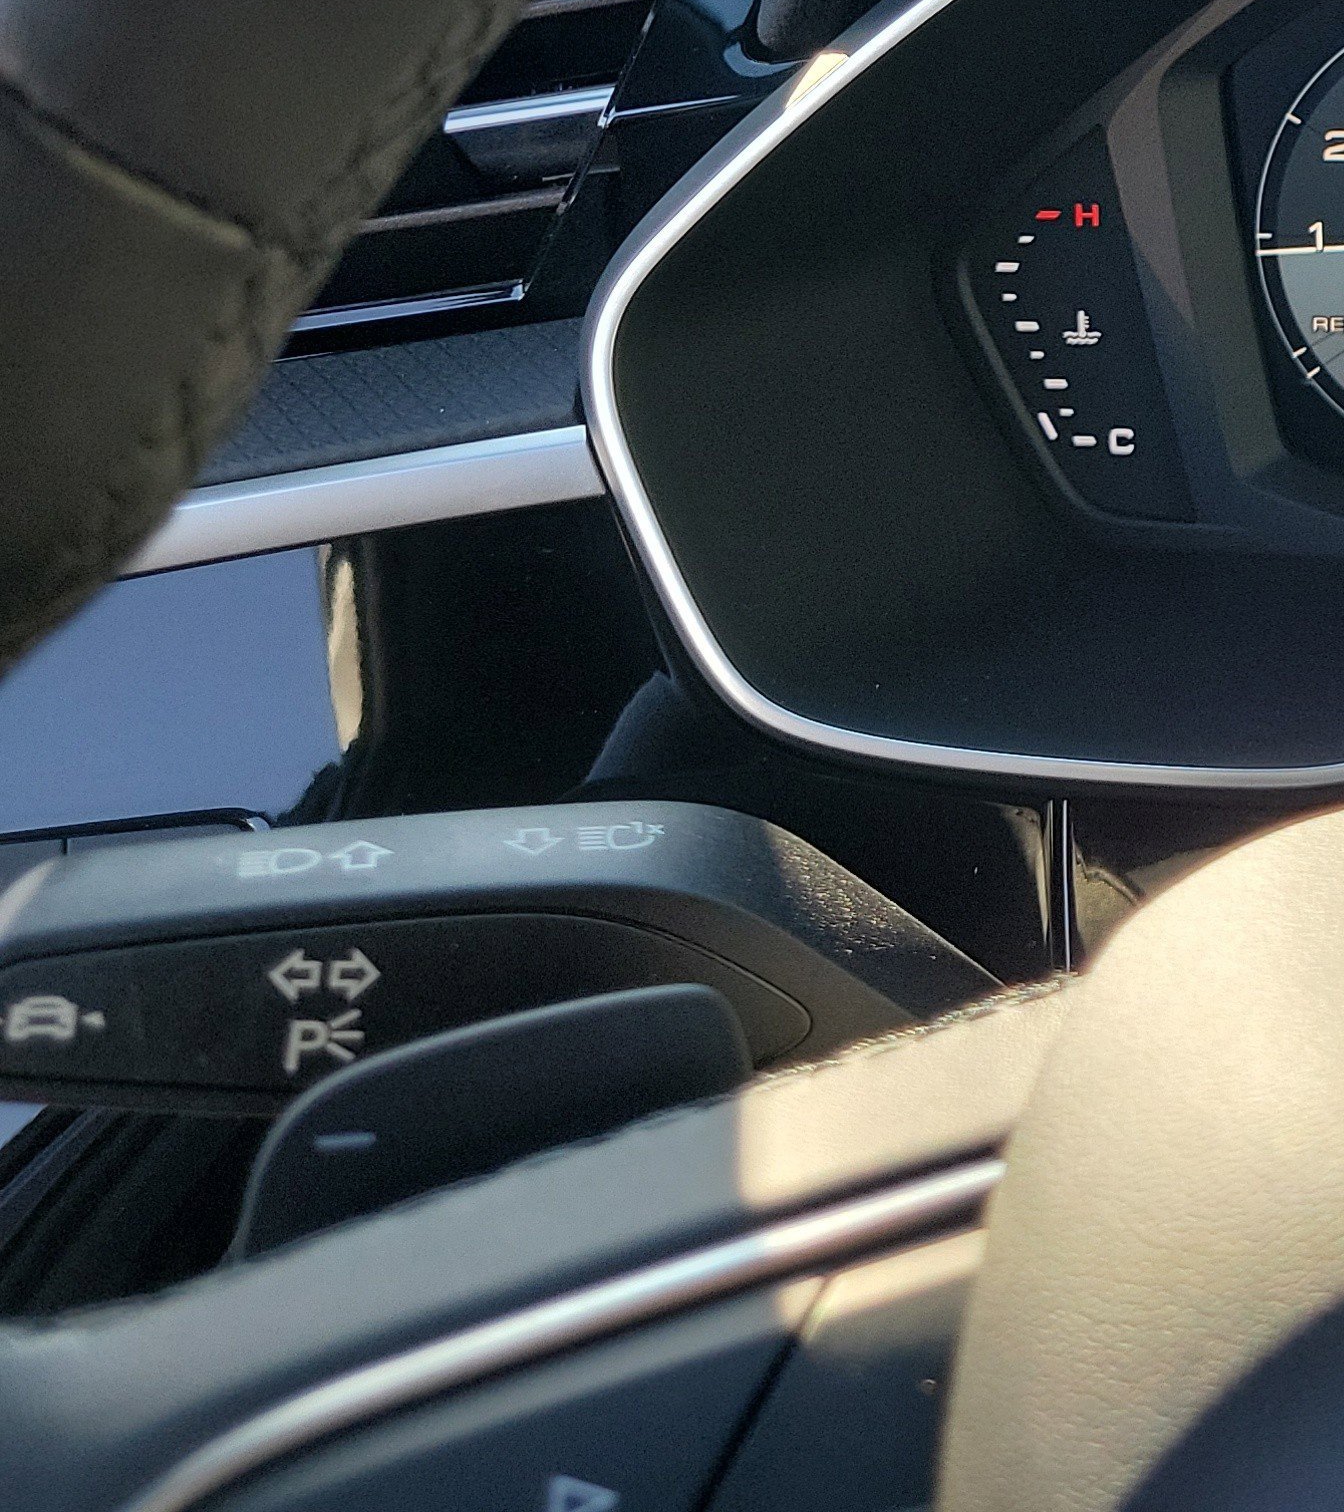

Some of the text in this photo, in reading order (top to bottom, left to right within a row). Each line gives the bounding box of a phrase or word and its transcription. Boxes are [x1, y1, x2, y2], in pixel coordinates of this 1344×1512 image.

[1075, 203, 1100, 227] H
[1308, 221, 1324, 251] 1
[1108, 427, 1135, 455] C
